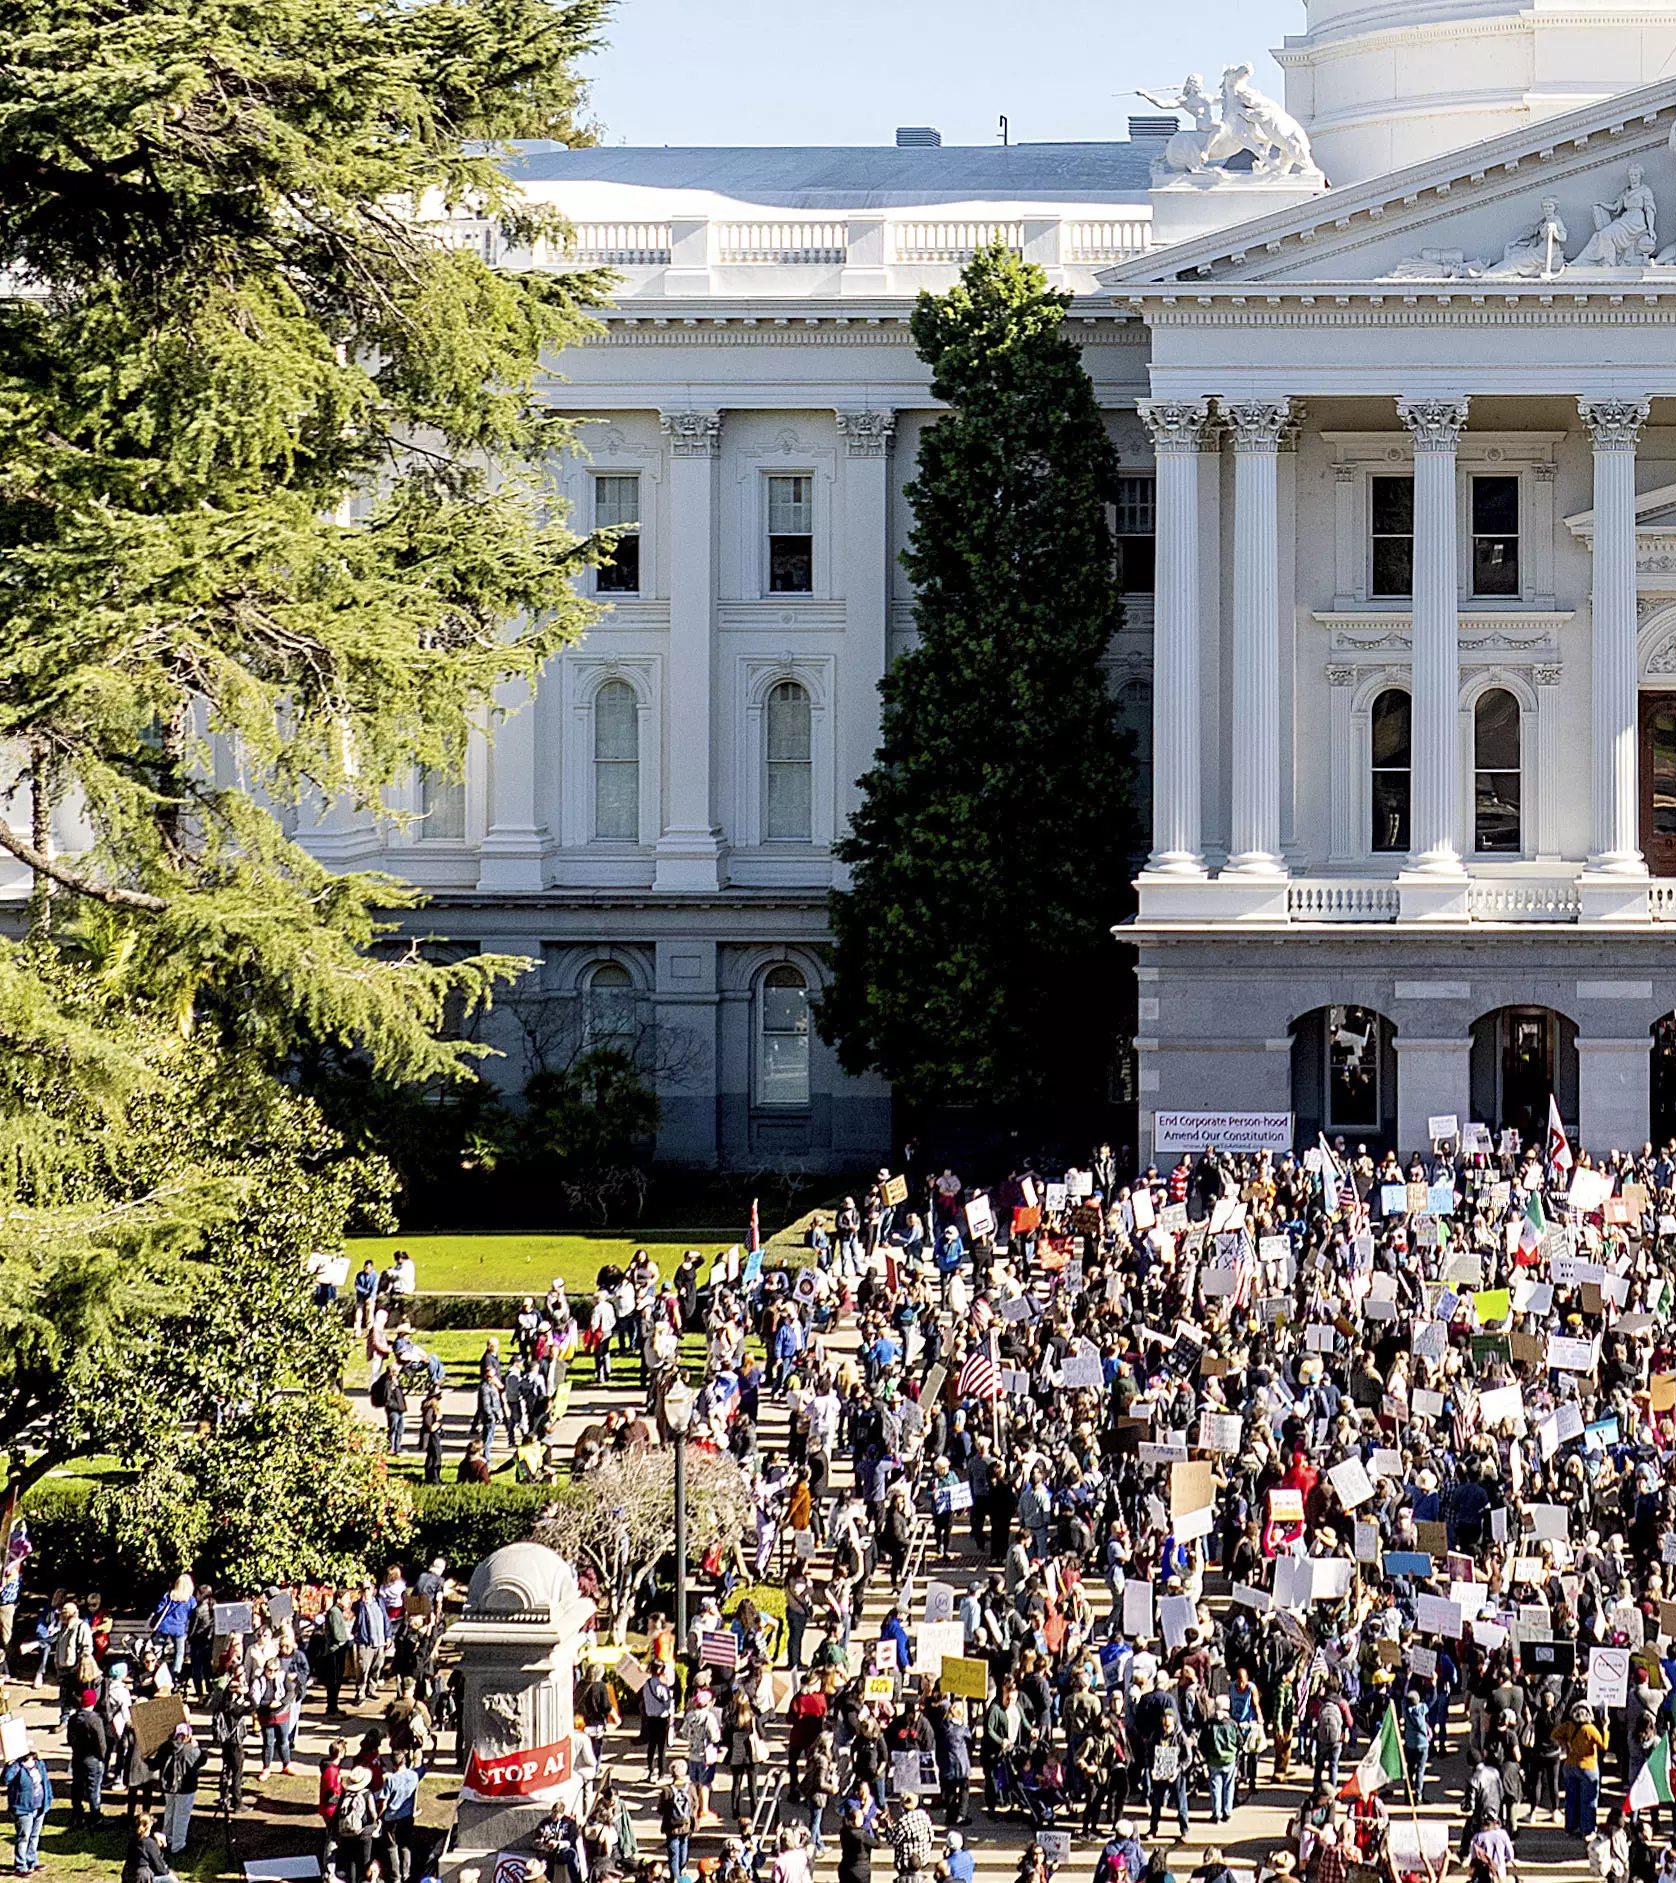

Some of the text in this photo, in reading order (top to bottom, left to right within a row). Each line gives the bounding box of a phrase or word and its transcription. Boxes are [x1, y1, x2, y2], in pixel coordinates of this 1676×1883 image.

[1159, 1115, 1288, 1128] End Corporate Person-hood
[1163, 1131, 1284, 1141] Amend Our Constitution
[479, 1752, 565, 1786] STOP AI
